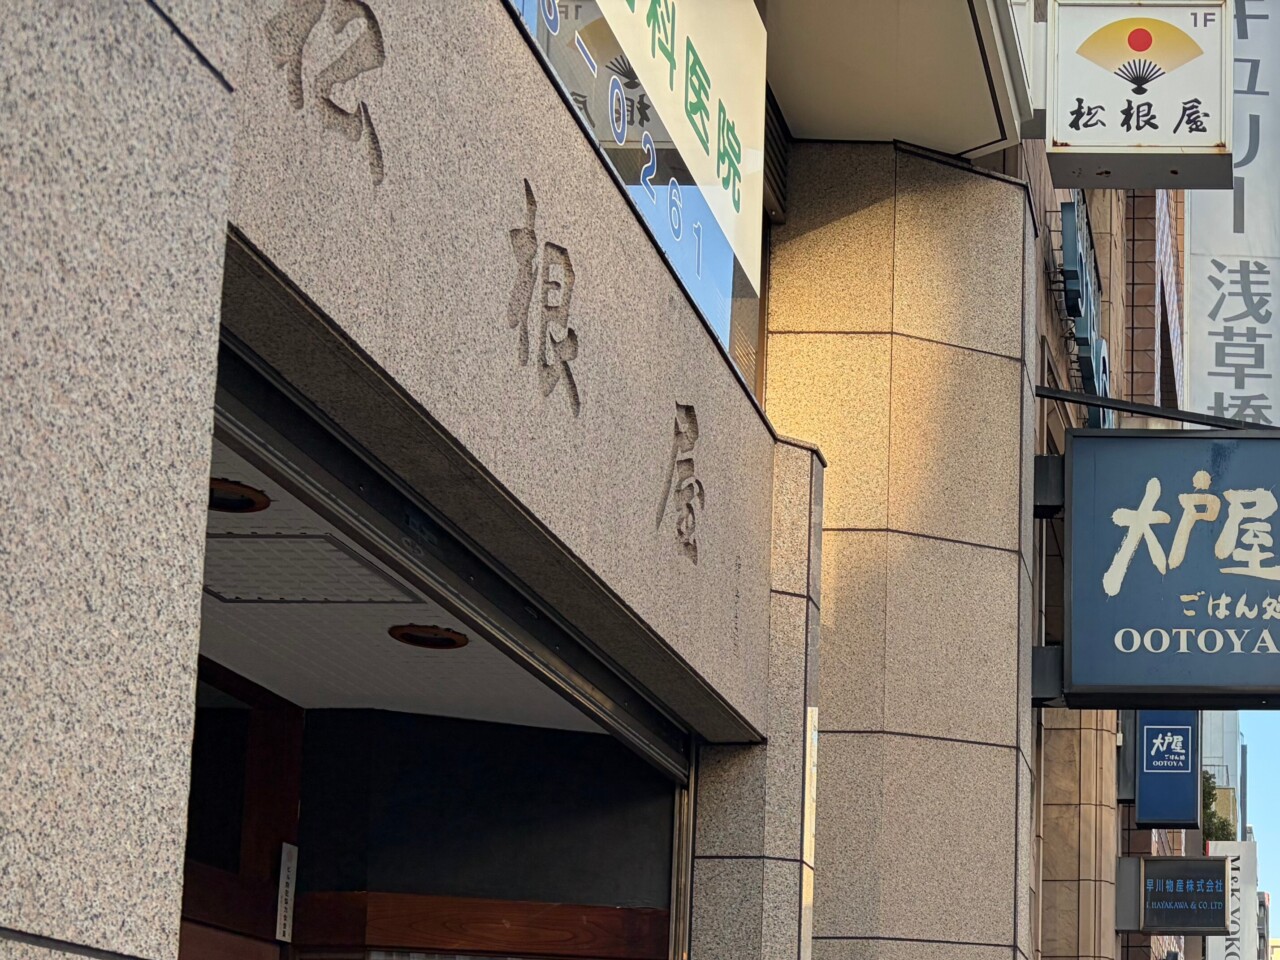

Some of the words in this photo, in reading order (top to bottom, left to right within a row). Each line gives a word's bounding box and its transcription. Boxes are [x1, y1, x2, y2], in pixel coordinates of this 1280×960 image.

[1191, 12, 1216, 27] 1F
[626, 0, 741, 213] 科医院
[1069, 98, 1210, 134] 松根屋
[1114, 627, 1280, 654] OOTOYA
[1151, 732, 1186, 756] 大戸屋
[1146, 879, 1223, 893] 早川物産株式会社
